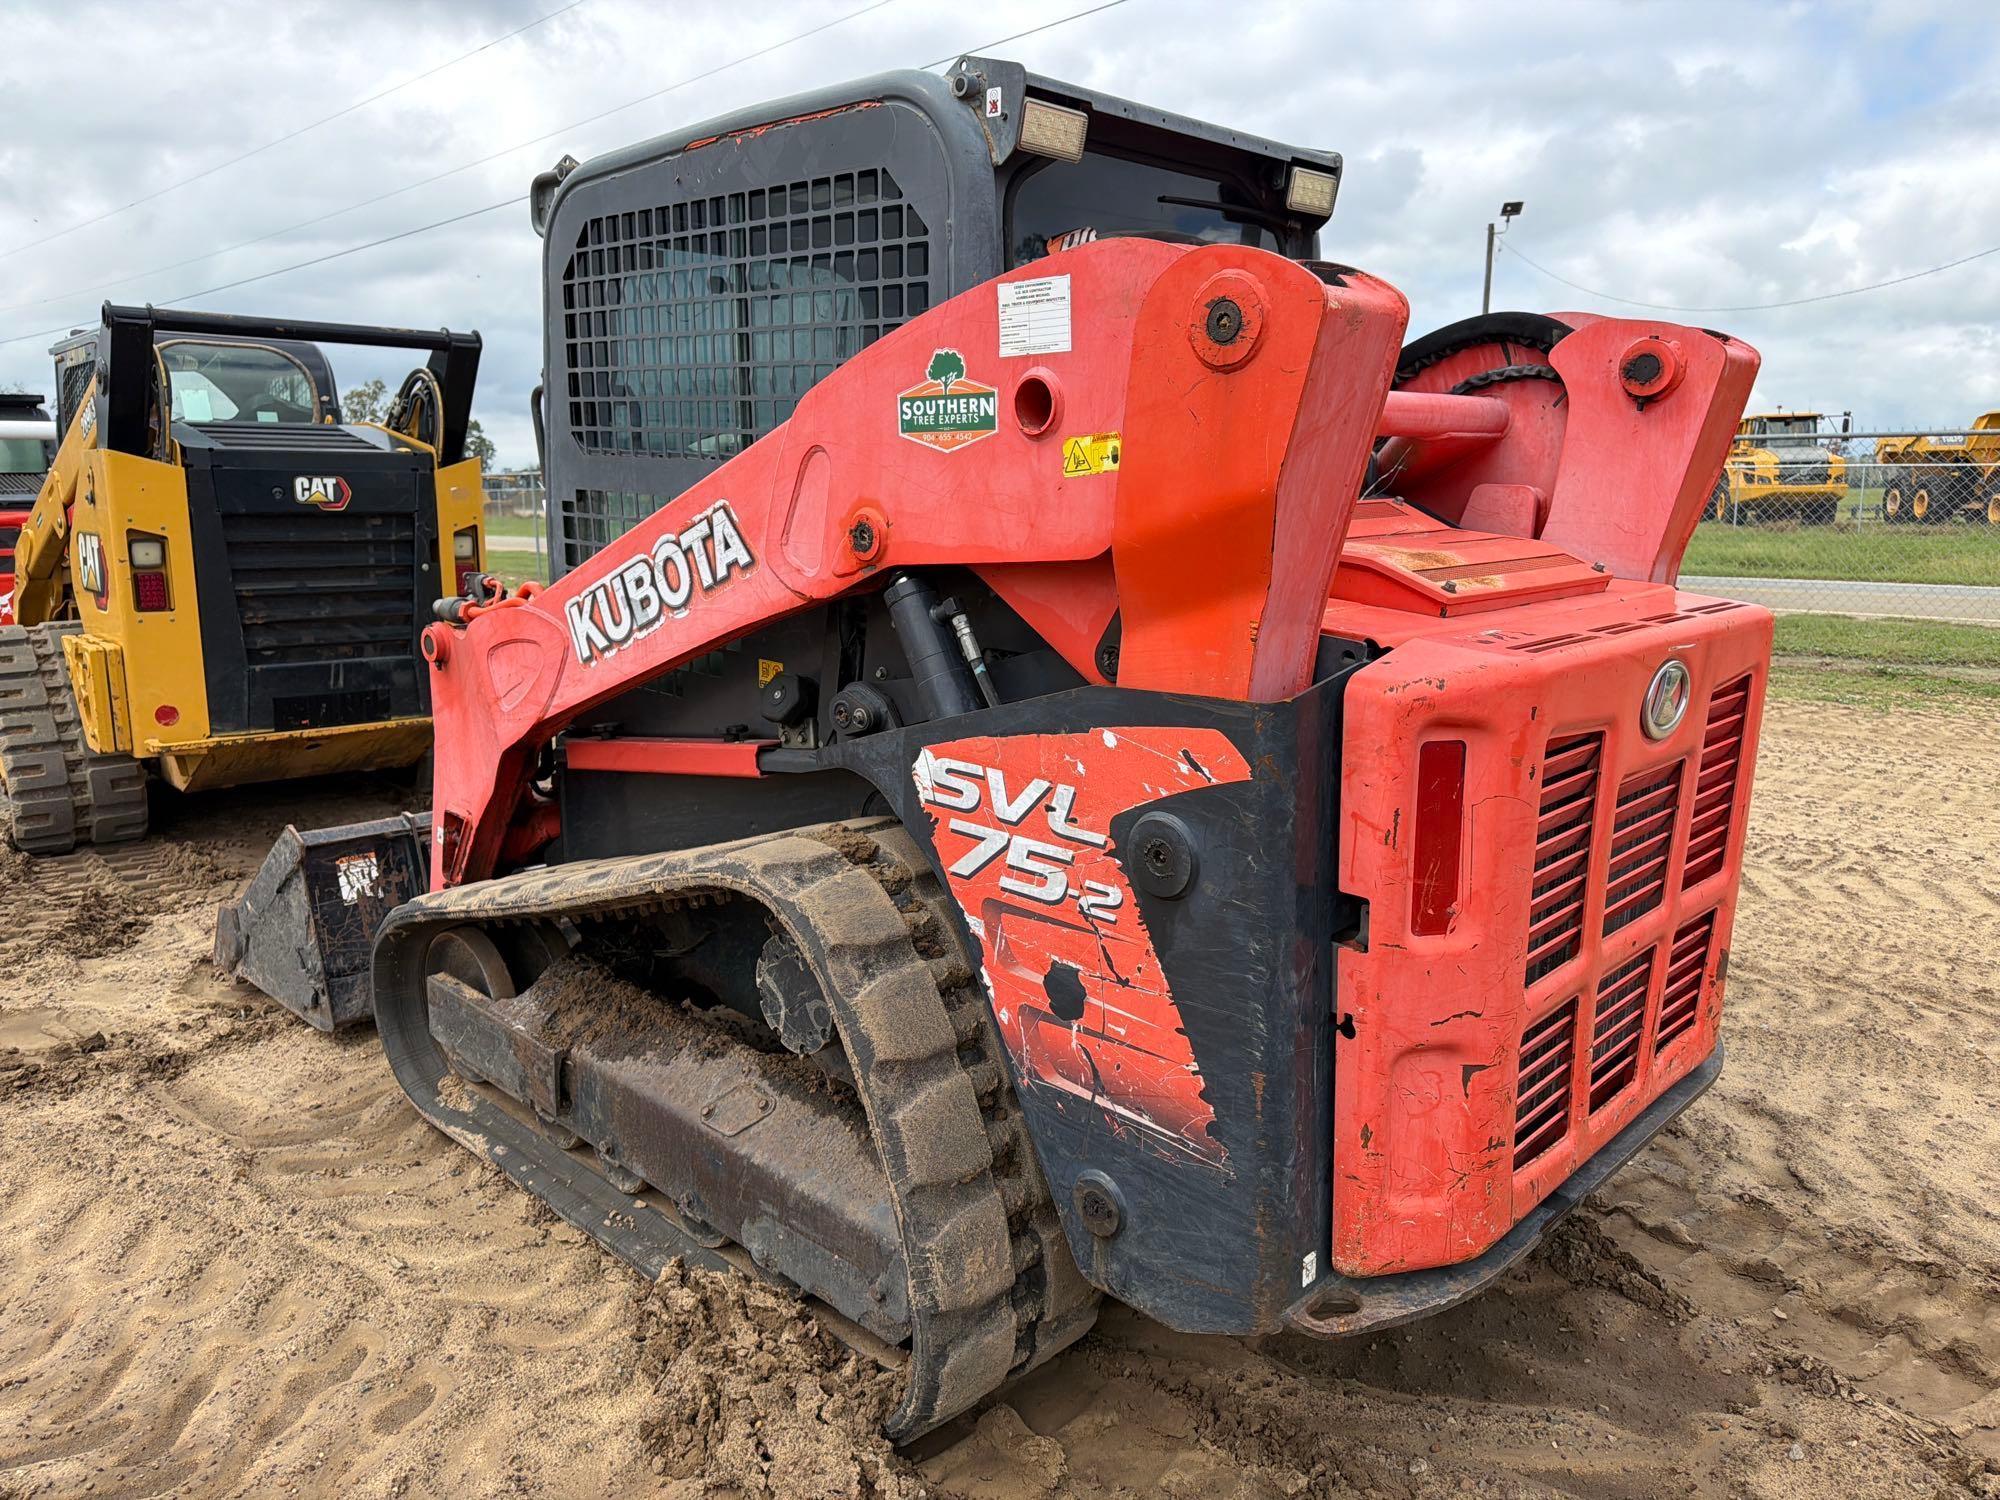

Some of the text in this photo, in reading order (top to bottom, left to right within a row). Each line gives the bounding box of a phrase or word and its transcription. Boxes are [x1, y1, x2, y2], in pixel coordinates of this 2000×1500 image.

[902, 397, 994, 420] SOUTHERN
[913, 415, 935, 426] TREE
[938, 413, 979, 425] EXPERTS
[922, 434, 935, 442] 904
[956, 432, 973, 440] 4542
[295, 476, 337, 503] CAT
[78, 532, 101, 593] CAT
[568, 506, 753, 663] KUBOTA
[922, 756, 1108, 850] SVL
[948, 817, 1124, 925] 75-2
